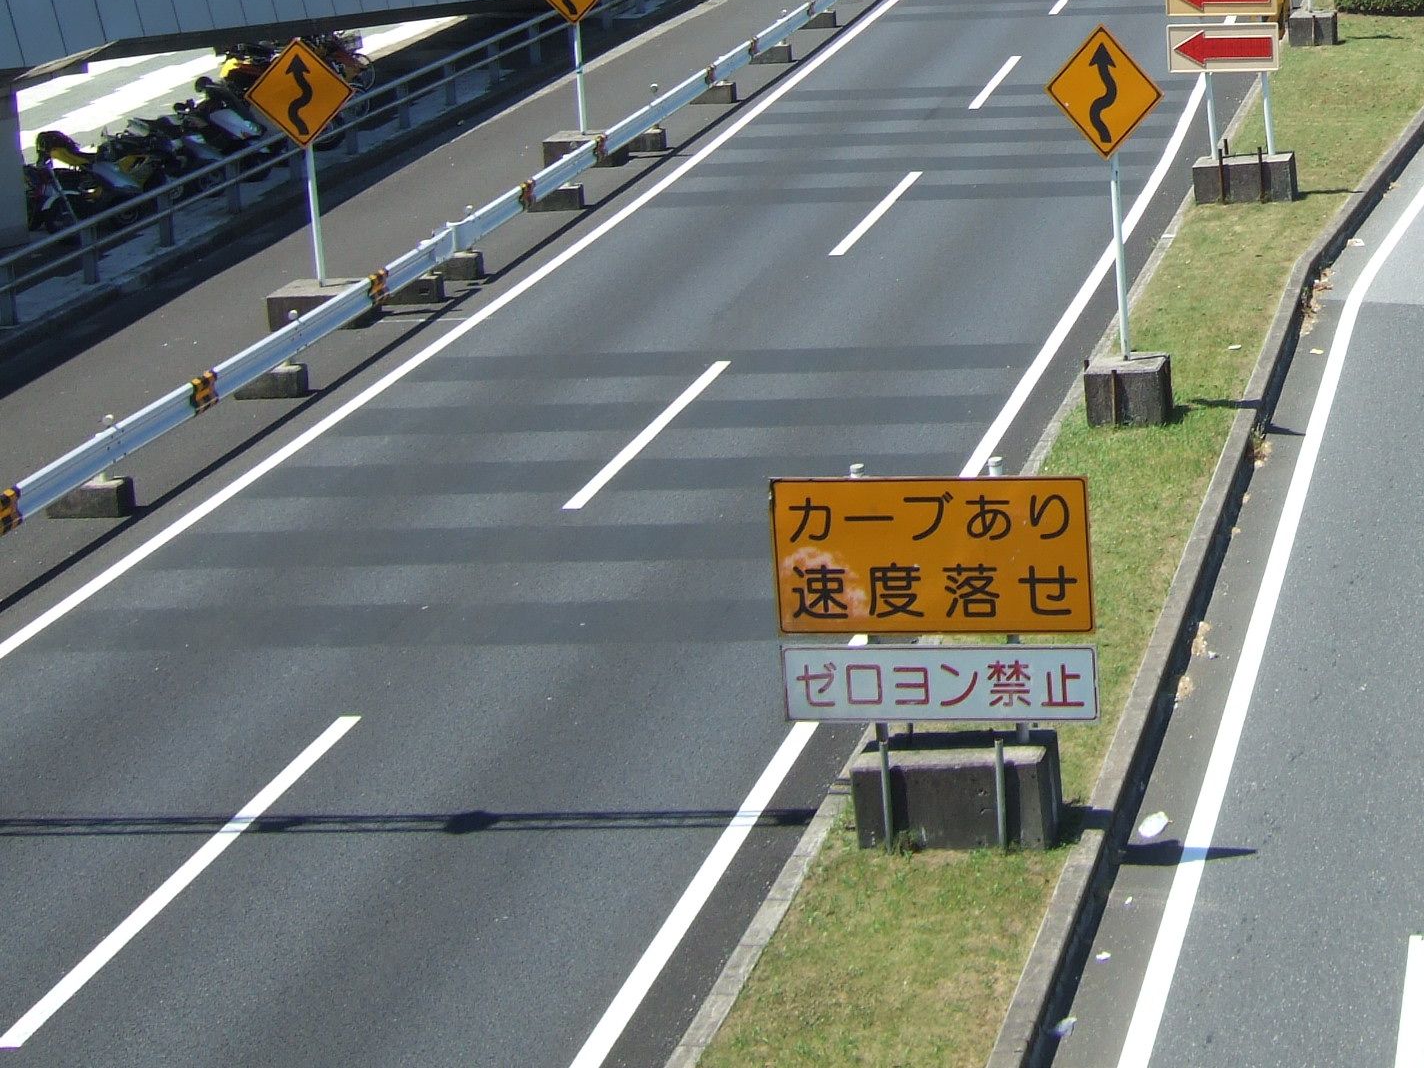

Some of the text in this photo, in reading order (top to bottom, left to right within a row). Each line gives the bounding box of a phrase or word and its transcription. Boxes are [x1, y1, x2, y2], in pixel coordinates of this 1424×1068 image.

[788, 491, 1070, 543] カーブあり
[792, 563, 1078, 619] 速度落せ
[796, 660, 1085, 707] ゼロヨン禁止
